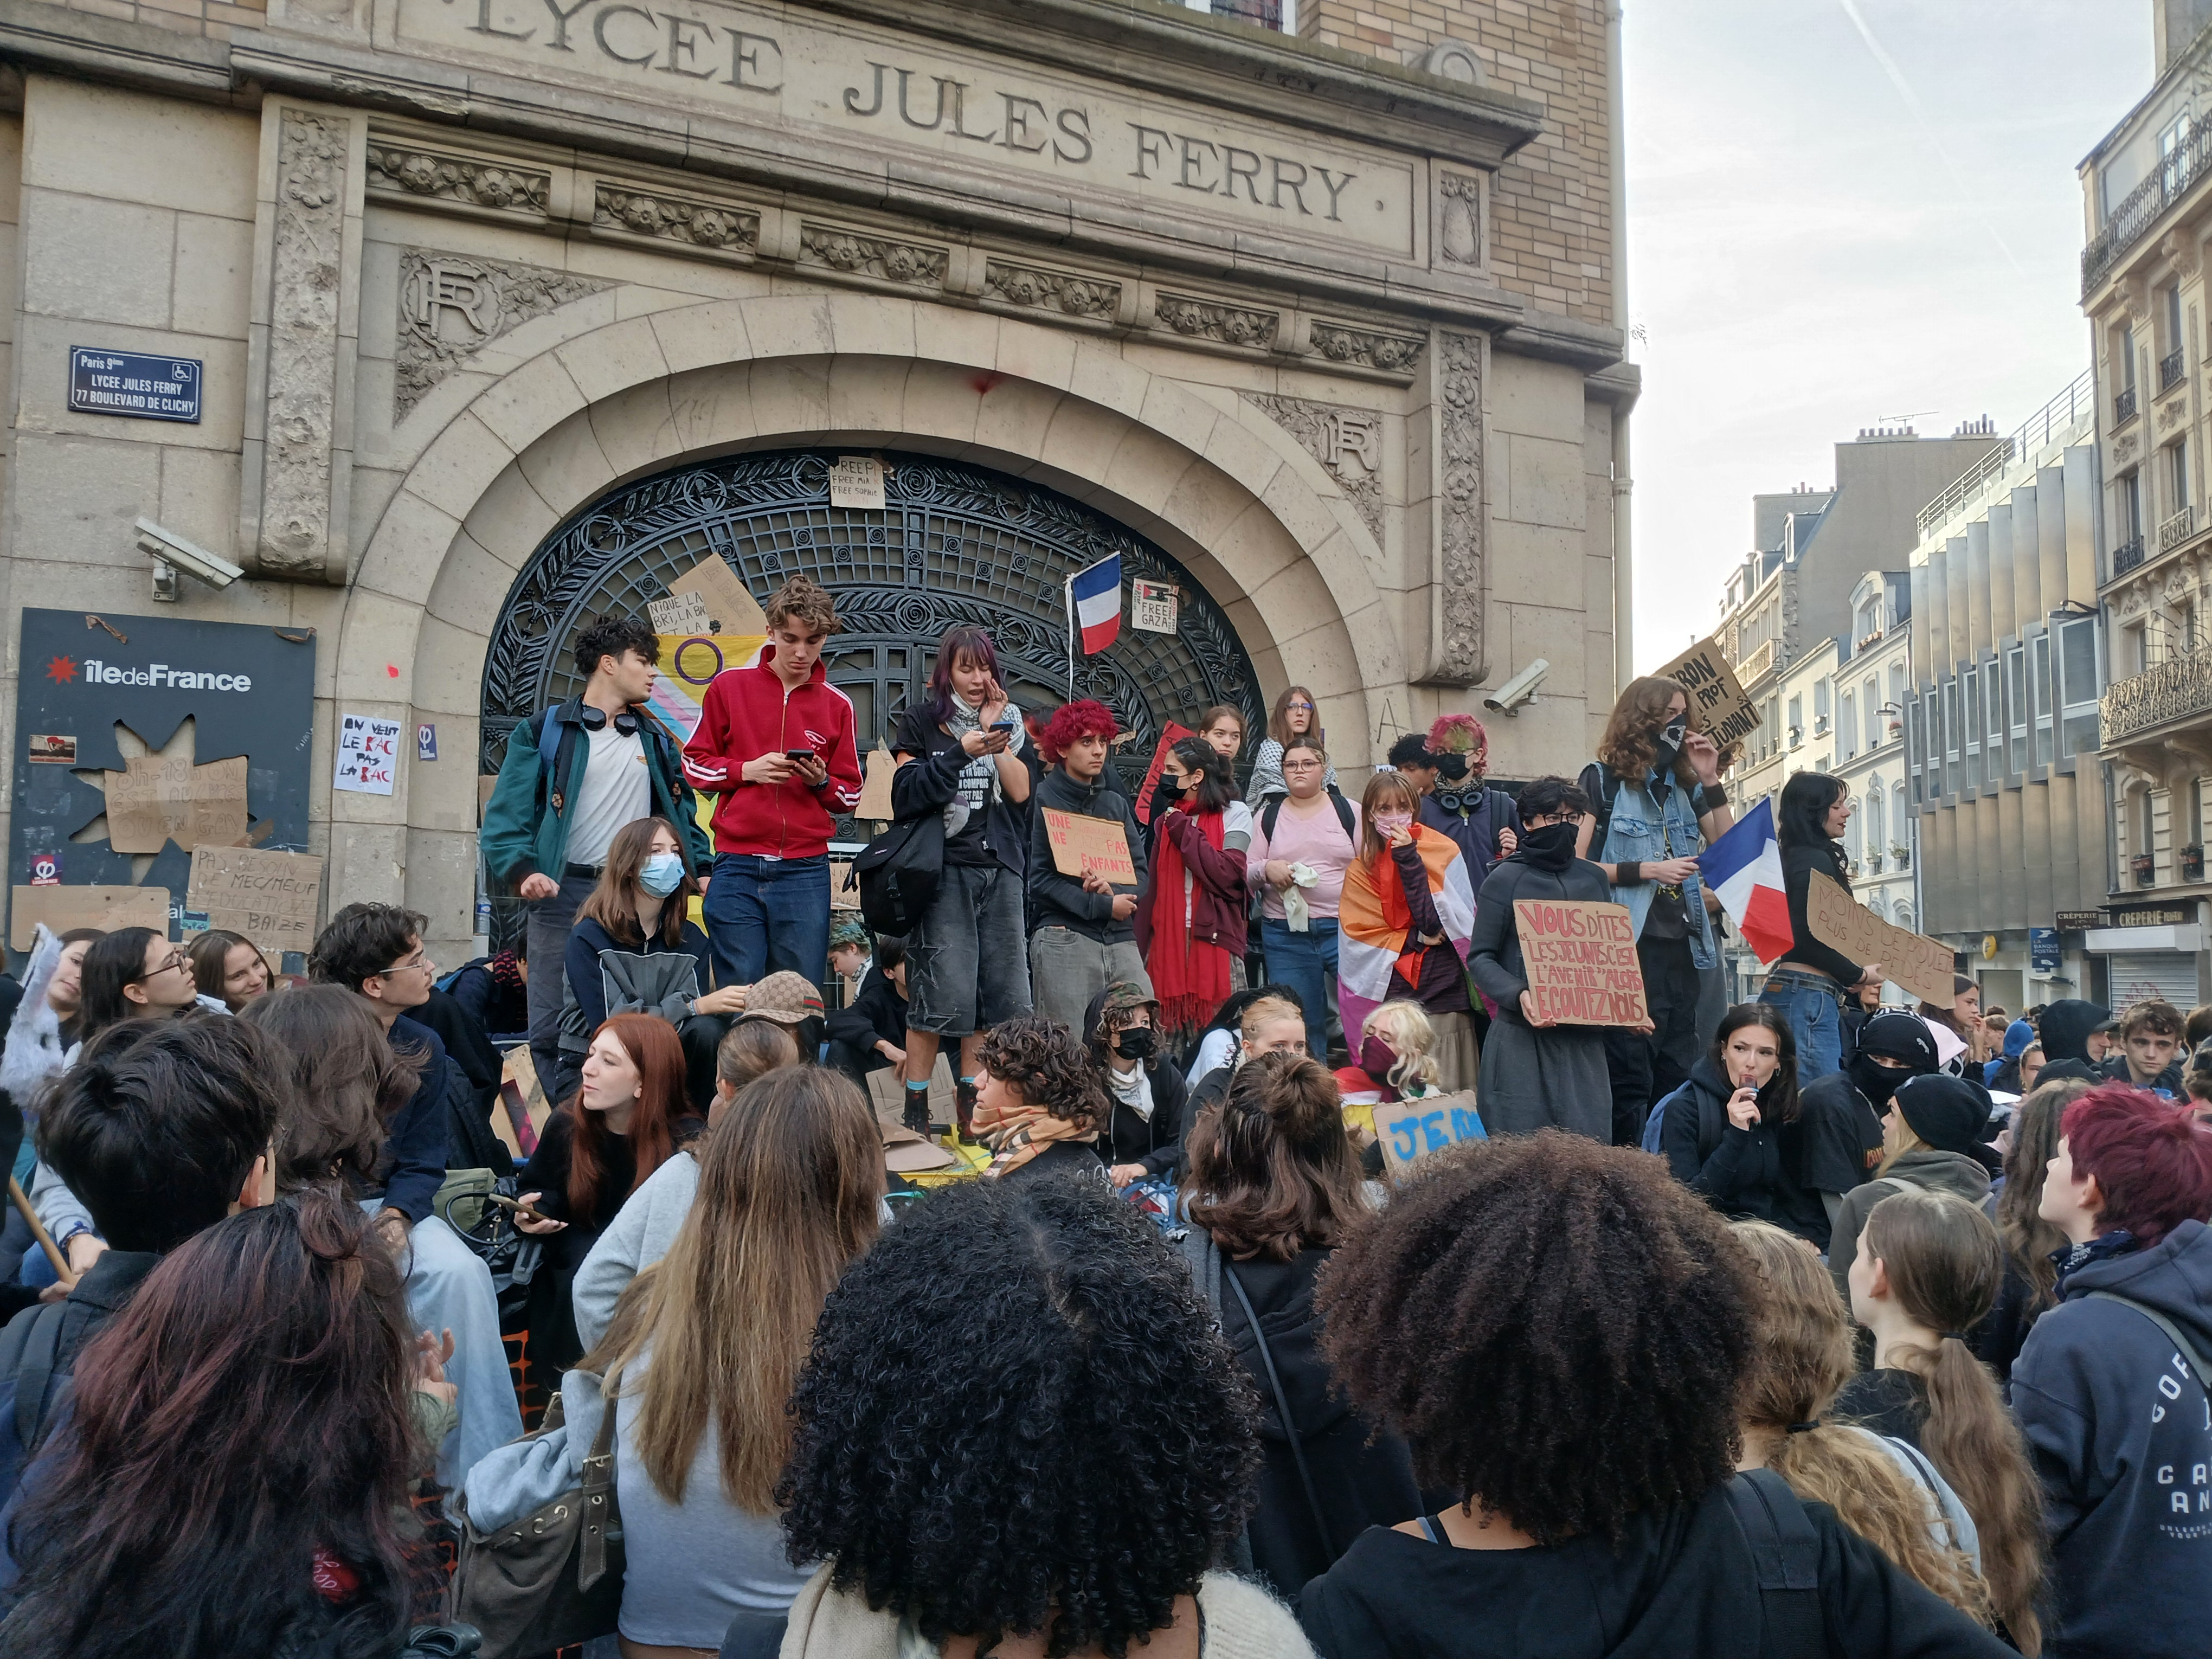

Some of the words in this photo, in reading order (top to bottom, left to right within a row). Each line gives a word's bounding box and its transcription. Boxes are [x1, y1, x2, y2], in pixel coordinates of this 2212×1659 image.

[843, 60, 1092, 165] JULES
[1126, 121, 1358, 222] FERRY
[81, 355, 105, 369] Paris
[92, 374, 120, 389] LYCEE
[122, 378, 151, 392] JULES
[153, 381, 182, 395] FERRY
[76, 389, 87, 402] 77
[90, 390, 145, 408] BOULEVARD
[147, 397, 159, 409] DE
[162, 398, 194, 413] CLICHY
[832, 475, 854, 484] FREE
[832, 486, 852, 494] FREE
[686, 591, 703, 606] LA
[678, 608, 693, 621] LA
[1142, 602, 1168, 616] FREE
[686, 622, 703, 635] LA
[1142, 614, 1168, 628] GAZA
[1696, 677, 1729, 710] PROF
[344, 718, 365, 731] ON
[342, 733, 361, 749] LE
[356, 753, 381, 766] PAS
[339, 763, 357, 775] LA
[963, 778, 989, 789] COMPRIS
[110, 789, 157, 813] EST
[972, 790, 983, 800] PAS
[1047, 813, 1072, 829] UNE
[1052, 831, 1067, 845] NE
[1106, 839, 1128, 855] PAS
[198, 851, 227, 870] PAS
[1081, 852, 1133, 874] ENFANTS
[230, 874, 317, 895] MEC/MEUF
[1517, 903, 1586, 938] VOUS
[1819, 886, 1874, 936] MOINS
[1881, 923, 1901, 951] DE
[2119, 910, 2162, 927] CREPERIE
[1818, 910, 1847, 940] PLUS
[1855, 938, 1871, 956] DE
[1535, 986, 1611, 1021] ECOUTEZ
[1607, 992, 1644, 1024] NOUS
[1389, 1110, 1450, 1161] JE
